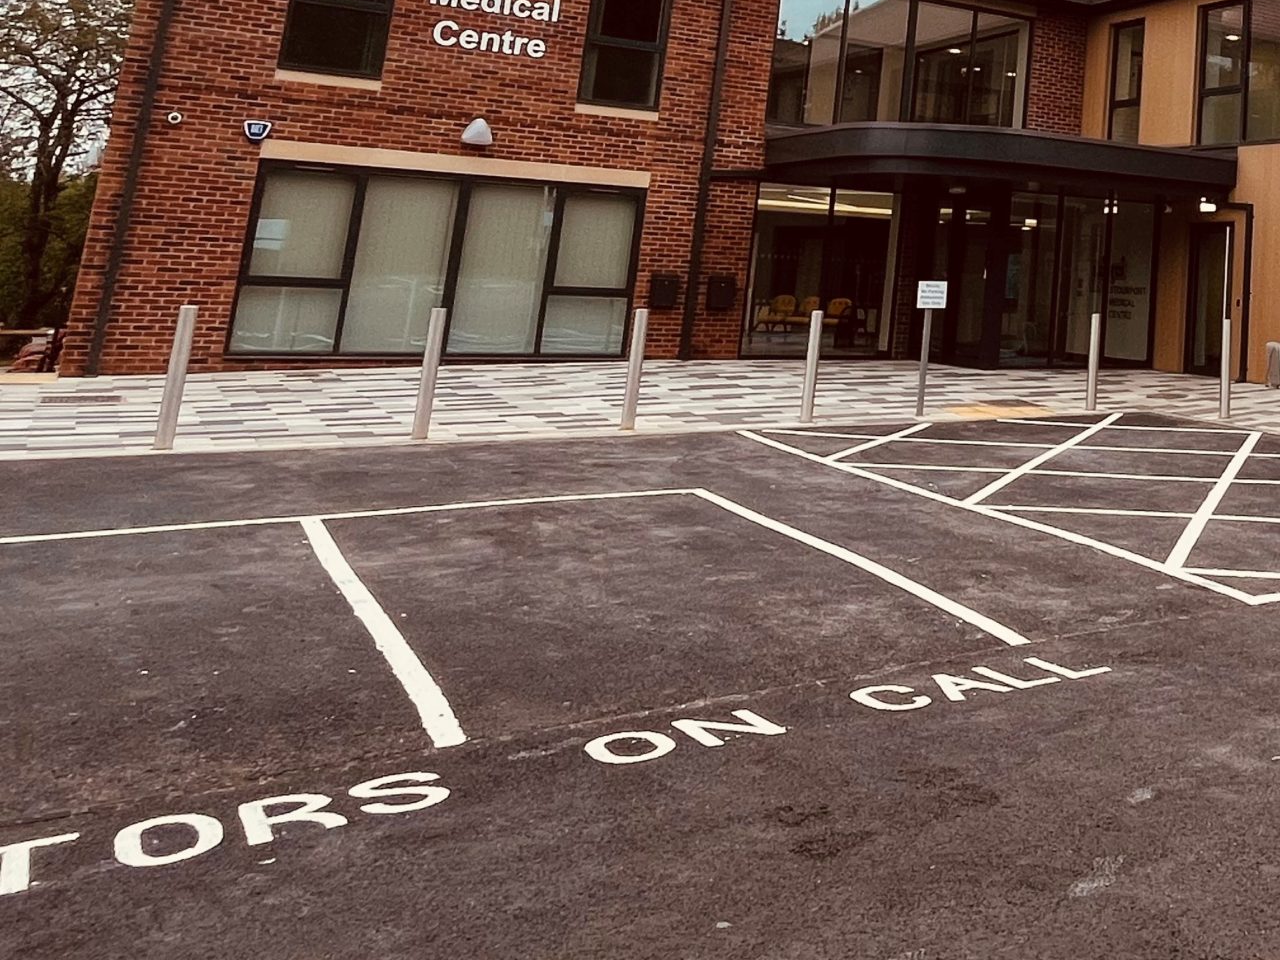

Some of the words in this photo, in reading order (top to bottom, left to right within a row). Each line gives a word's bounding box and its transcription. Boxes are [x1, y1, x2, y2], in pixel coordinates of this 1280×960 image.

[433, 20, 546, 58] Centre
[584, 709, 787, 764] ON
[849, 656, 1112, 711] CALL
